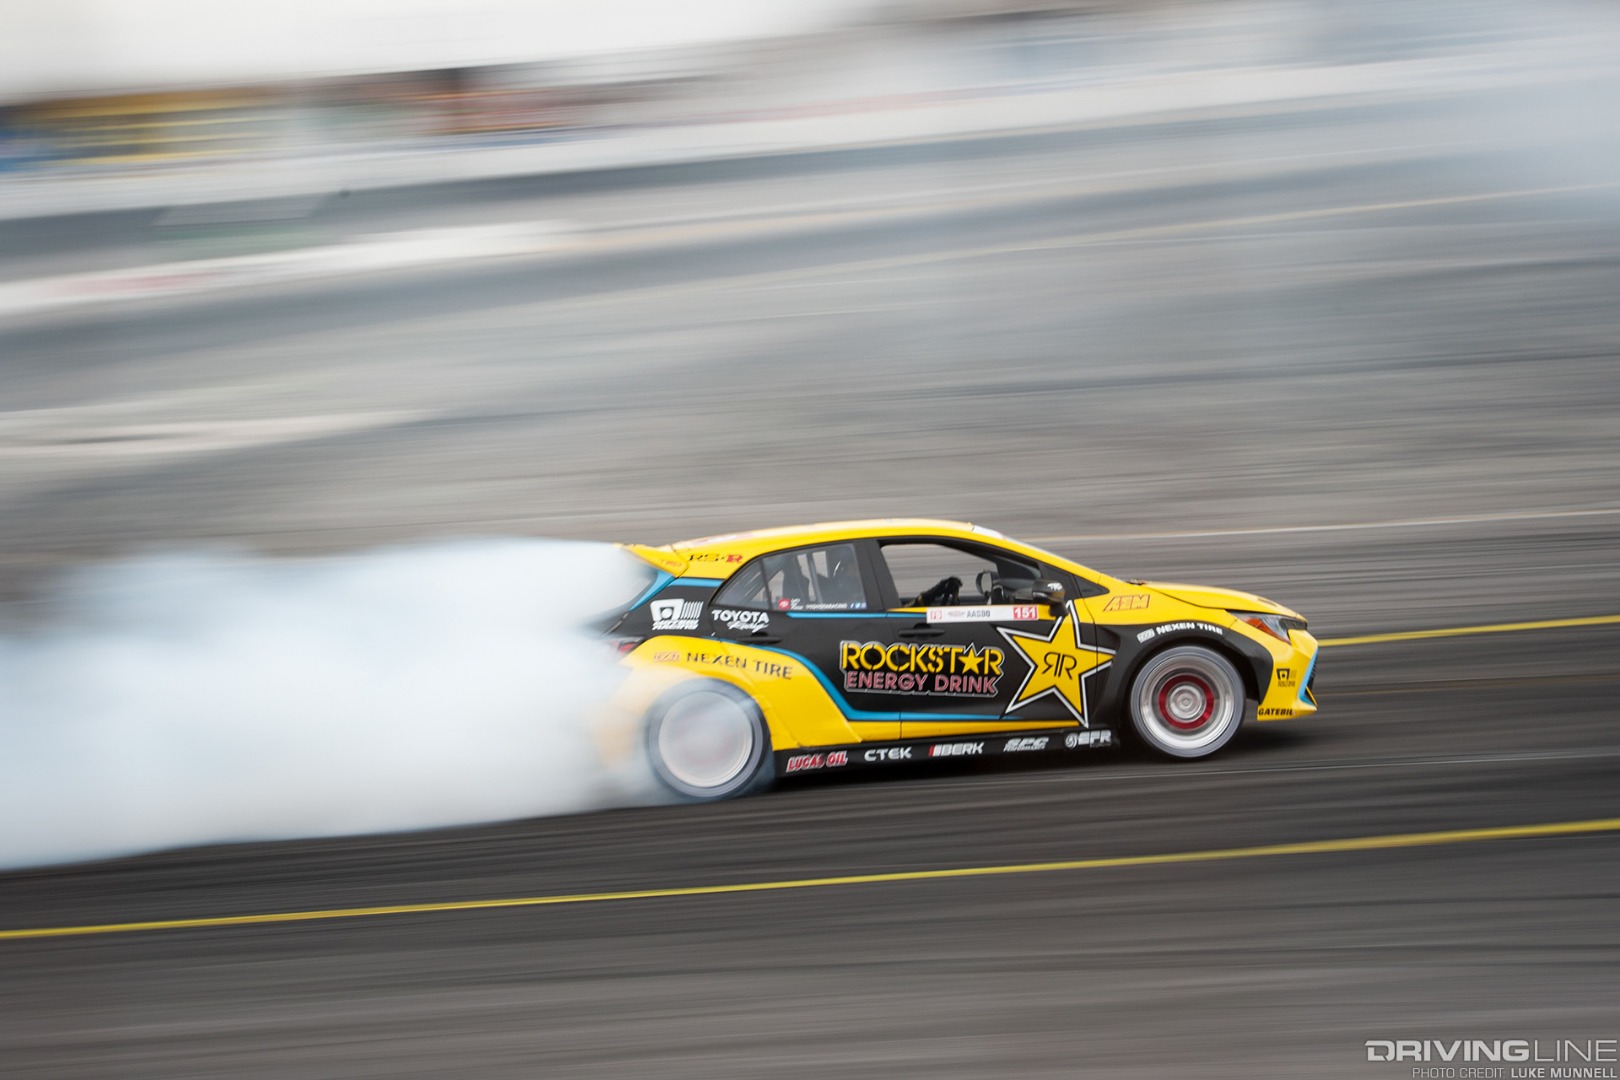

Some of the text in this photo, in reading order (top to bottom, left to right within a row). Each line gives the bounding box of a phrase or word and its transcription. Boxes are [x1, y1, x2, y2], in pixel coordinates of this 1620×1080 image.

[1103, 593, 1150, 612] AEM
[711, 609, 769, 624] TOYOTA
[1013, 606, 1037, 620] 151
[1156, 621, 1195, 636] NEXEN
[1197, 622, 1224, 636] TIRE
[686, 652, 747, 669] NEXEN
[752, 659, 793, 680] TIRE
[840, 641, 1005, 676] ROCKSTAR
[846, 670, 998, 694] ENERGY DRINK
[786, 751, 849, 773] LUCAS OIL
[864, 747, 912, 762] CTEK
